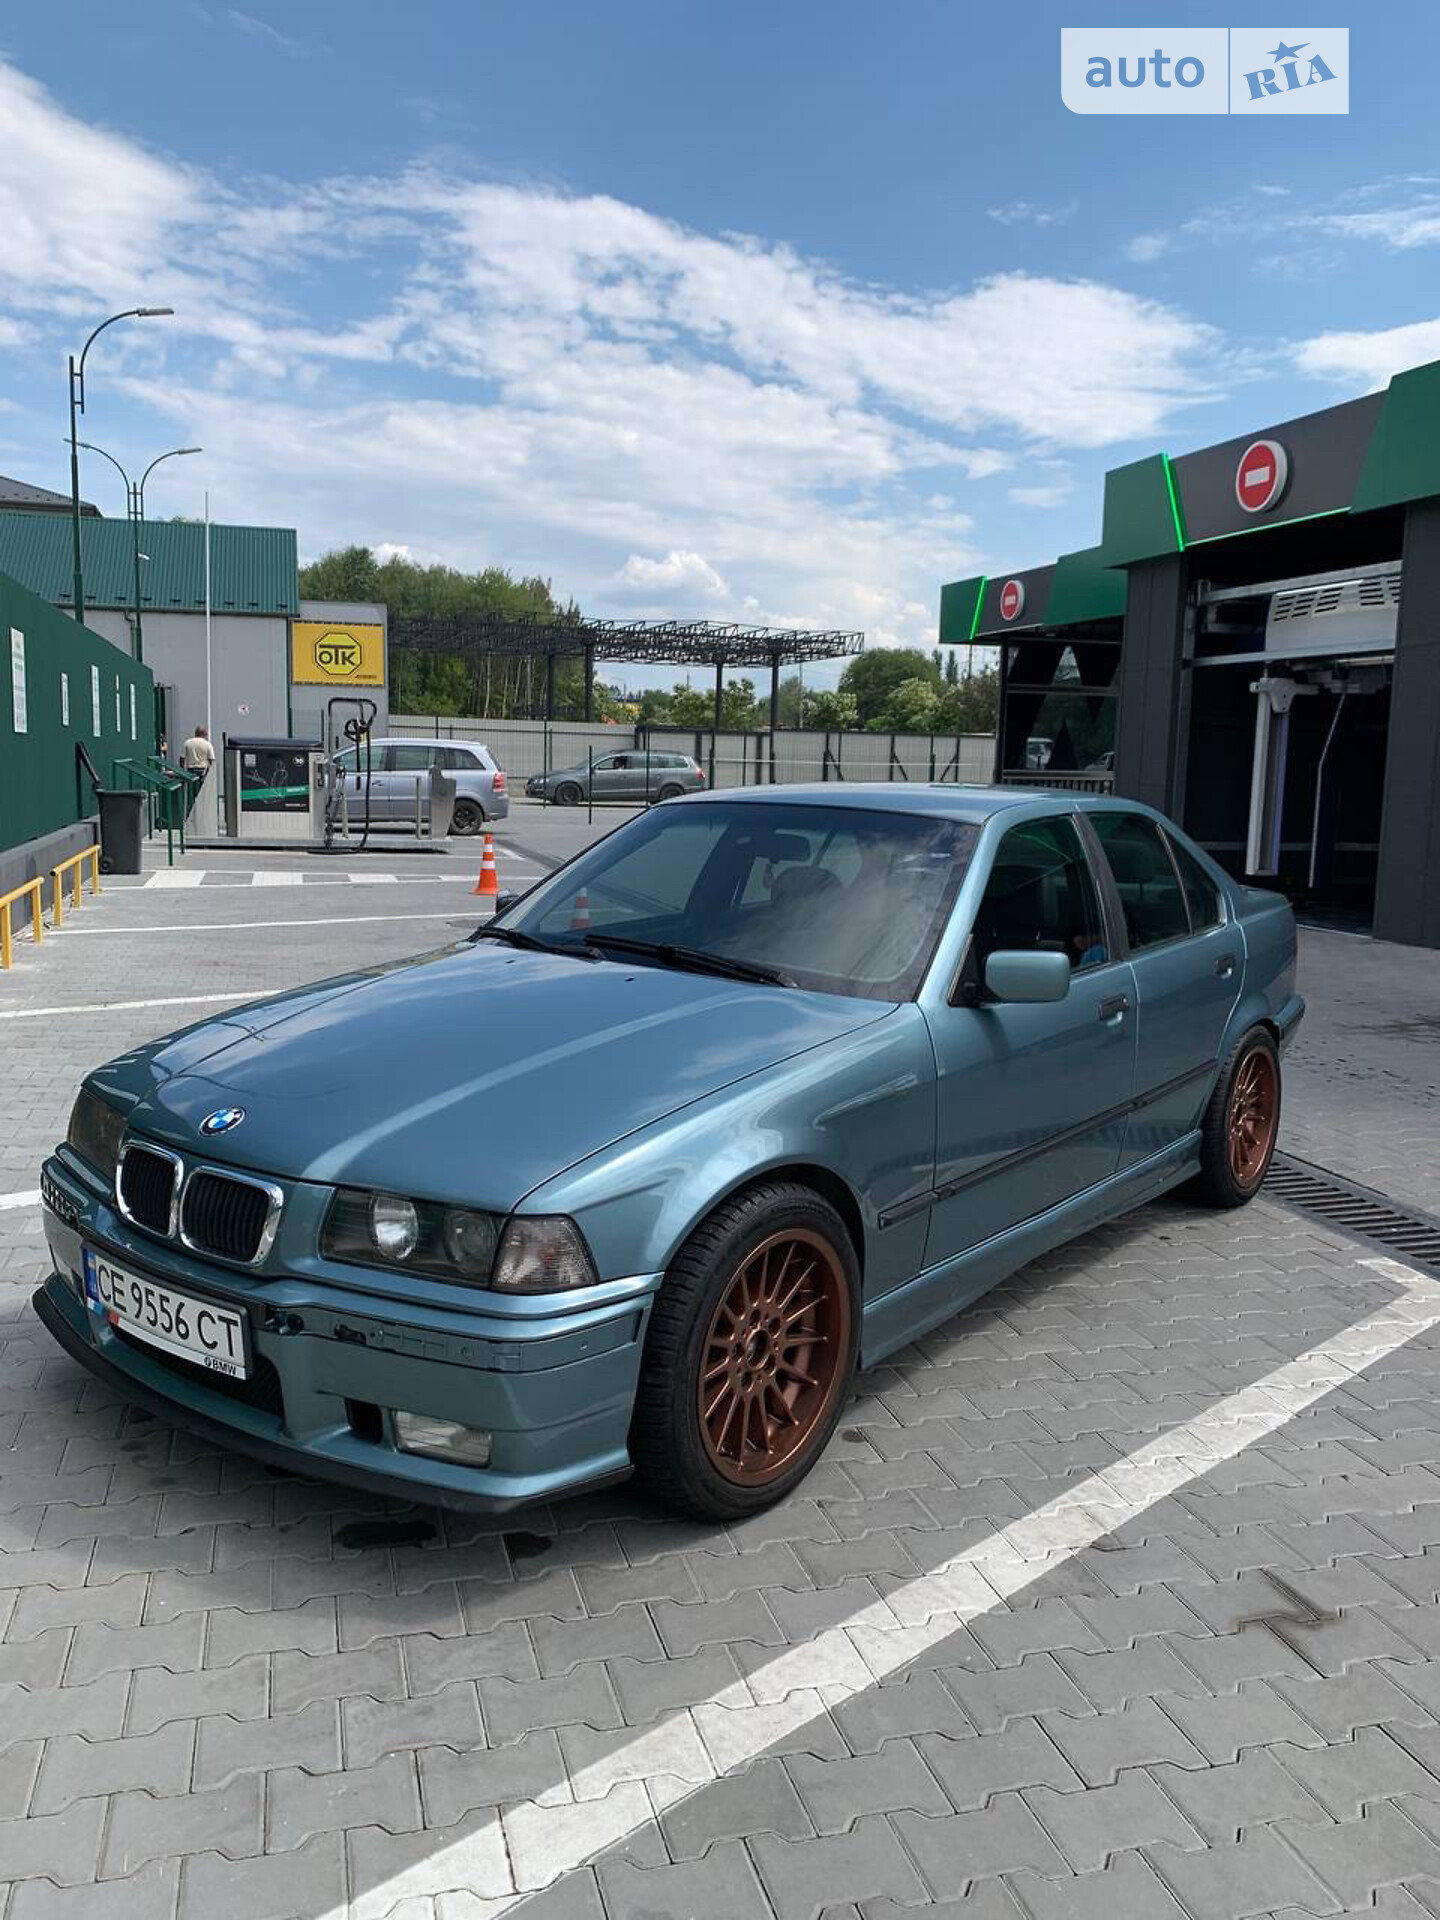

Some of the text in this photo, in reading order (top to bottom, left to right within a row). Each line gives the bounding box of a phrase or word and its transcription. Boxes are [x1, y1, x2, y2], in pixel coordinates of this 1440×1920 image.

[98, 1264, 239, 1358] CE 9556 CT
[212, 1361, 237, 1376] BMW
